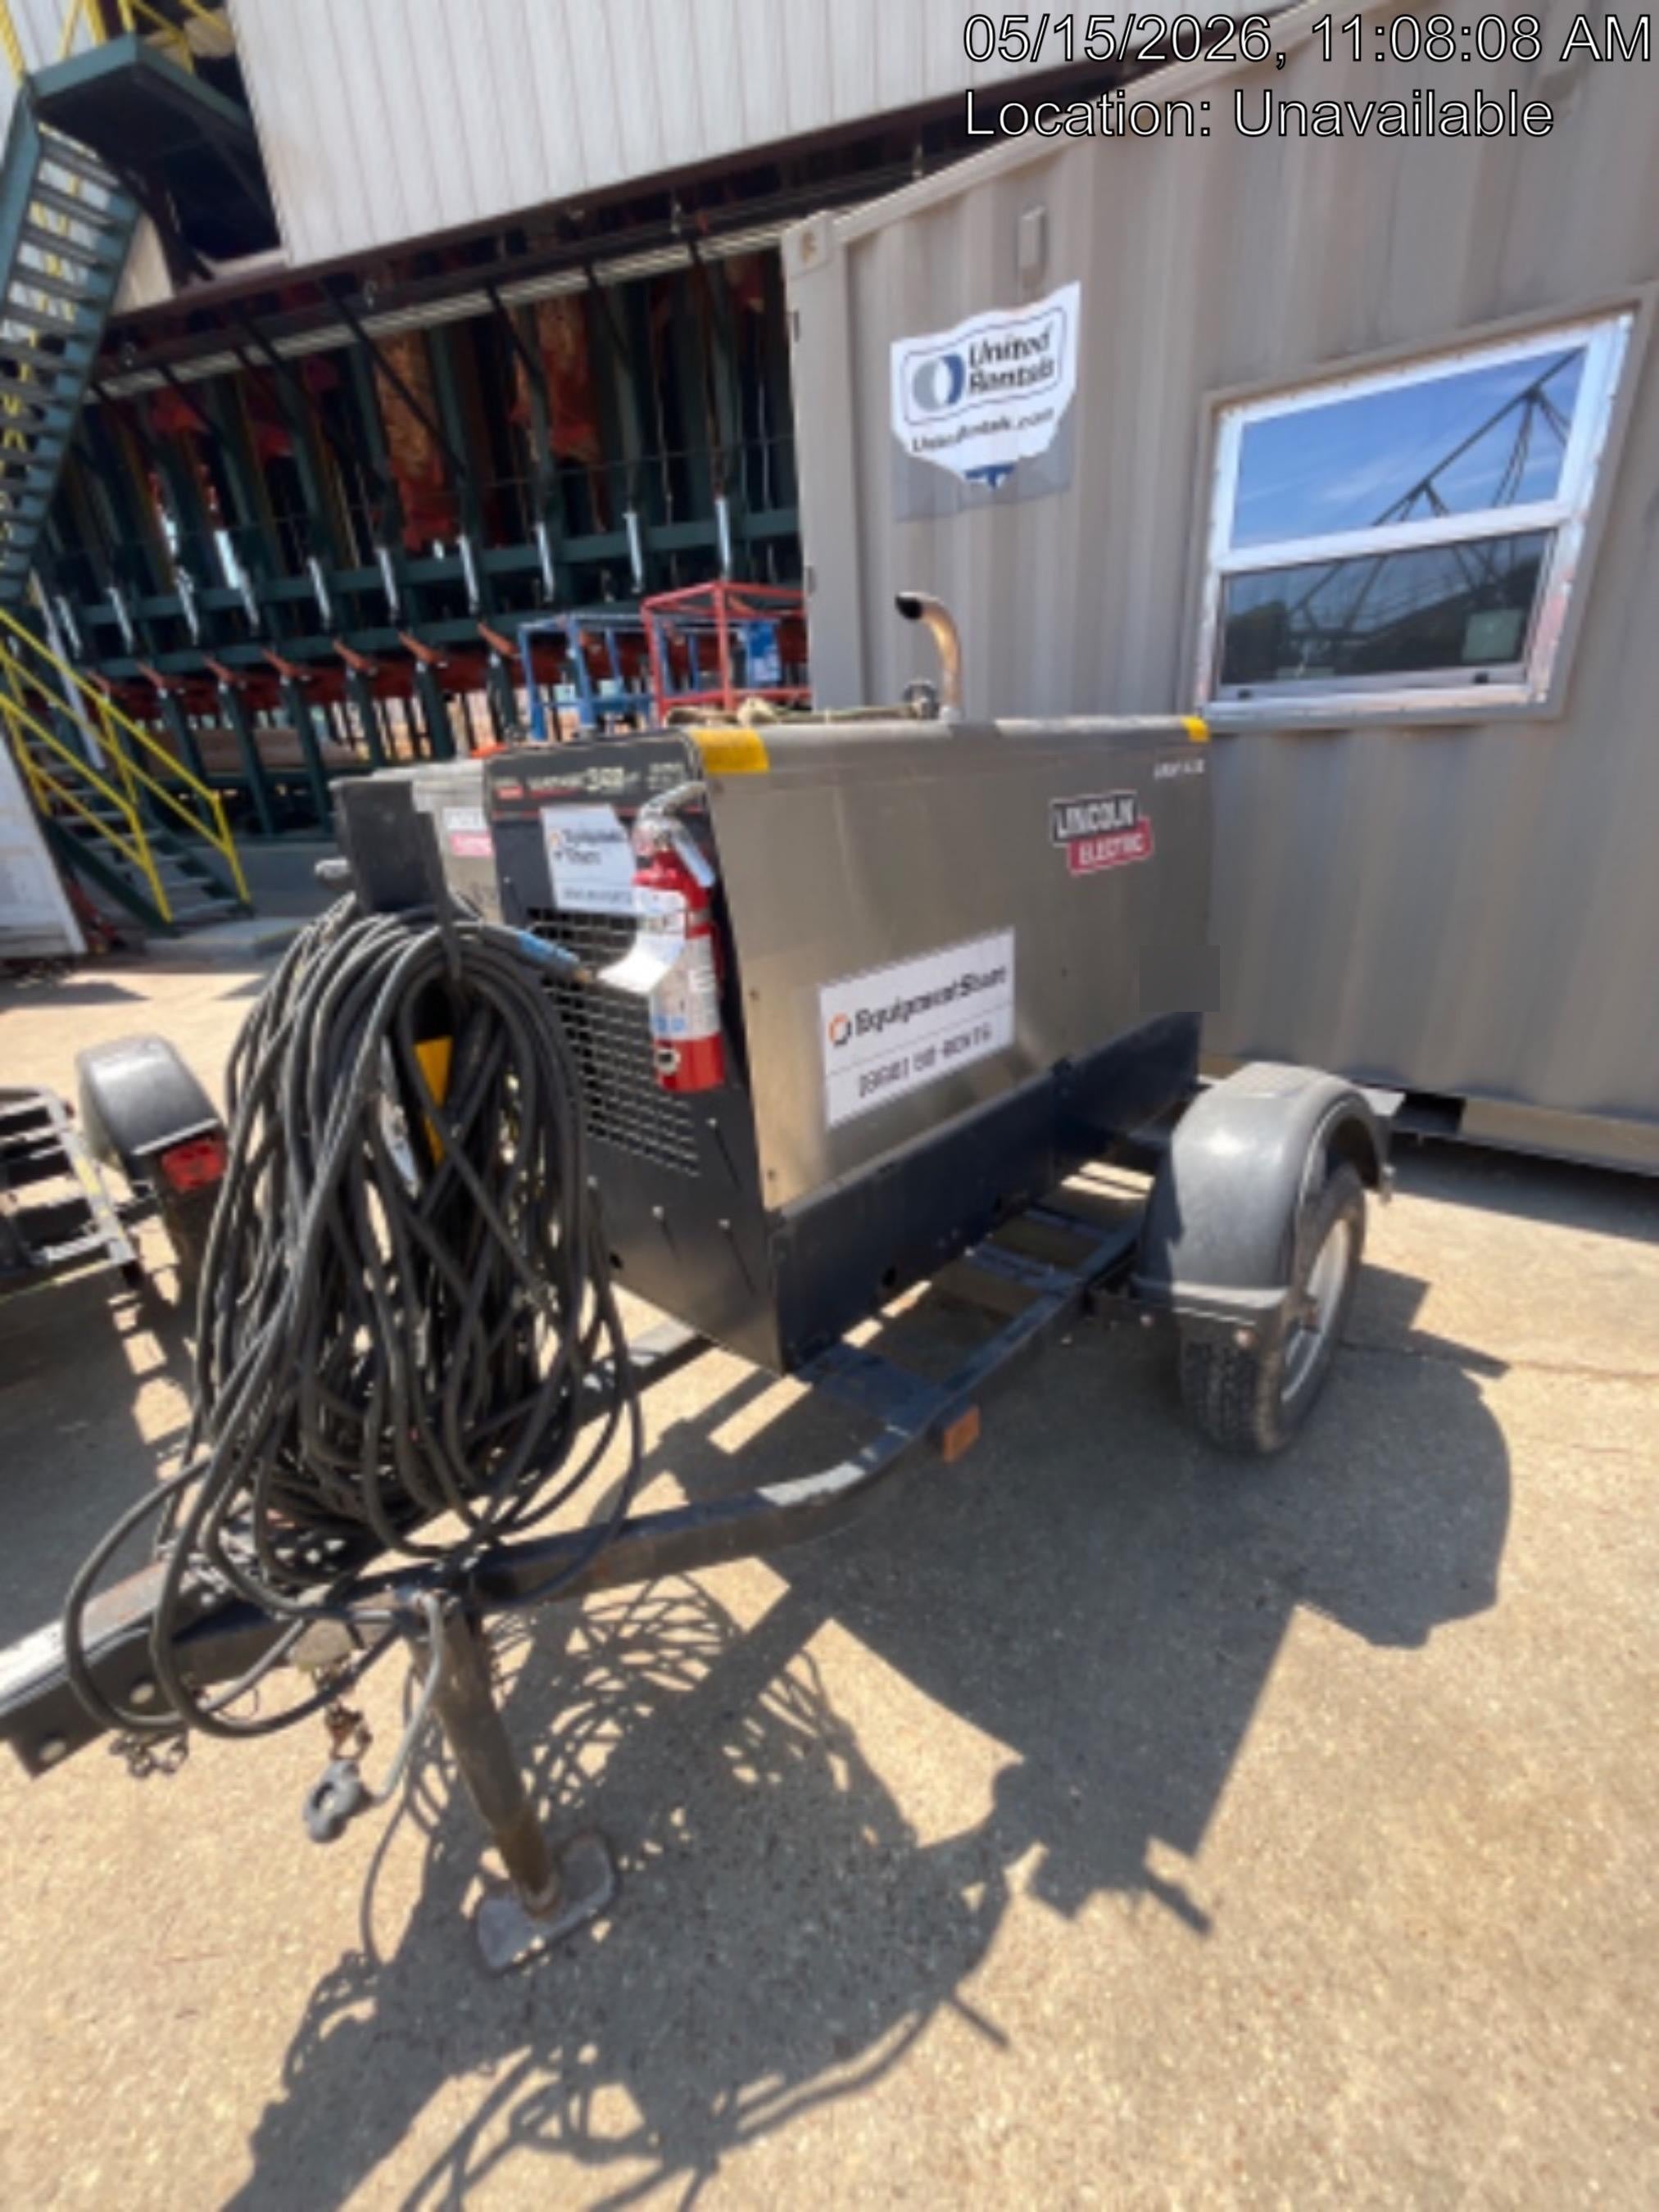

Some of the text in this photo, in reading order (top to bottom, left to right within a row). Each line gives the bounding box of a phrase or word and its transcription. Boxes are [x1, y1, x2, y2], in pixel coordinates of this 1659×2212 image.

[969, 323, 1053, 369] United
[969, 358, 1055, 392] Rentals
[1056, 797, 1135, 840] LINCOLN
[1078, 832, 1144, 866] ELECTRIC
